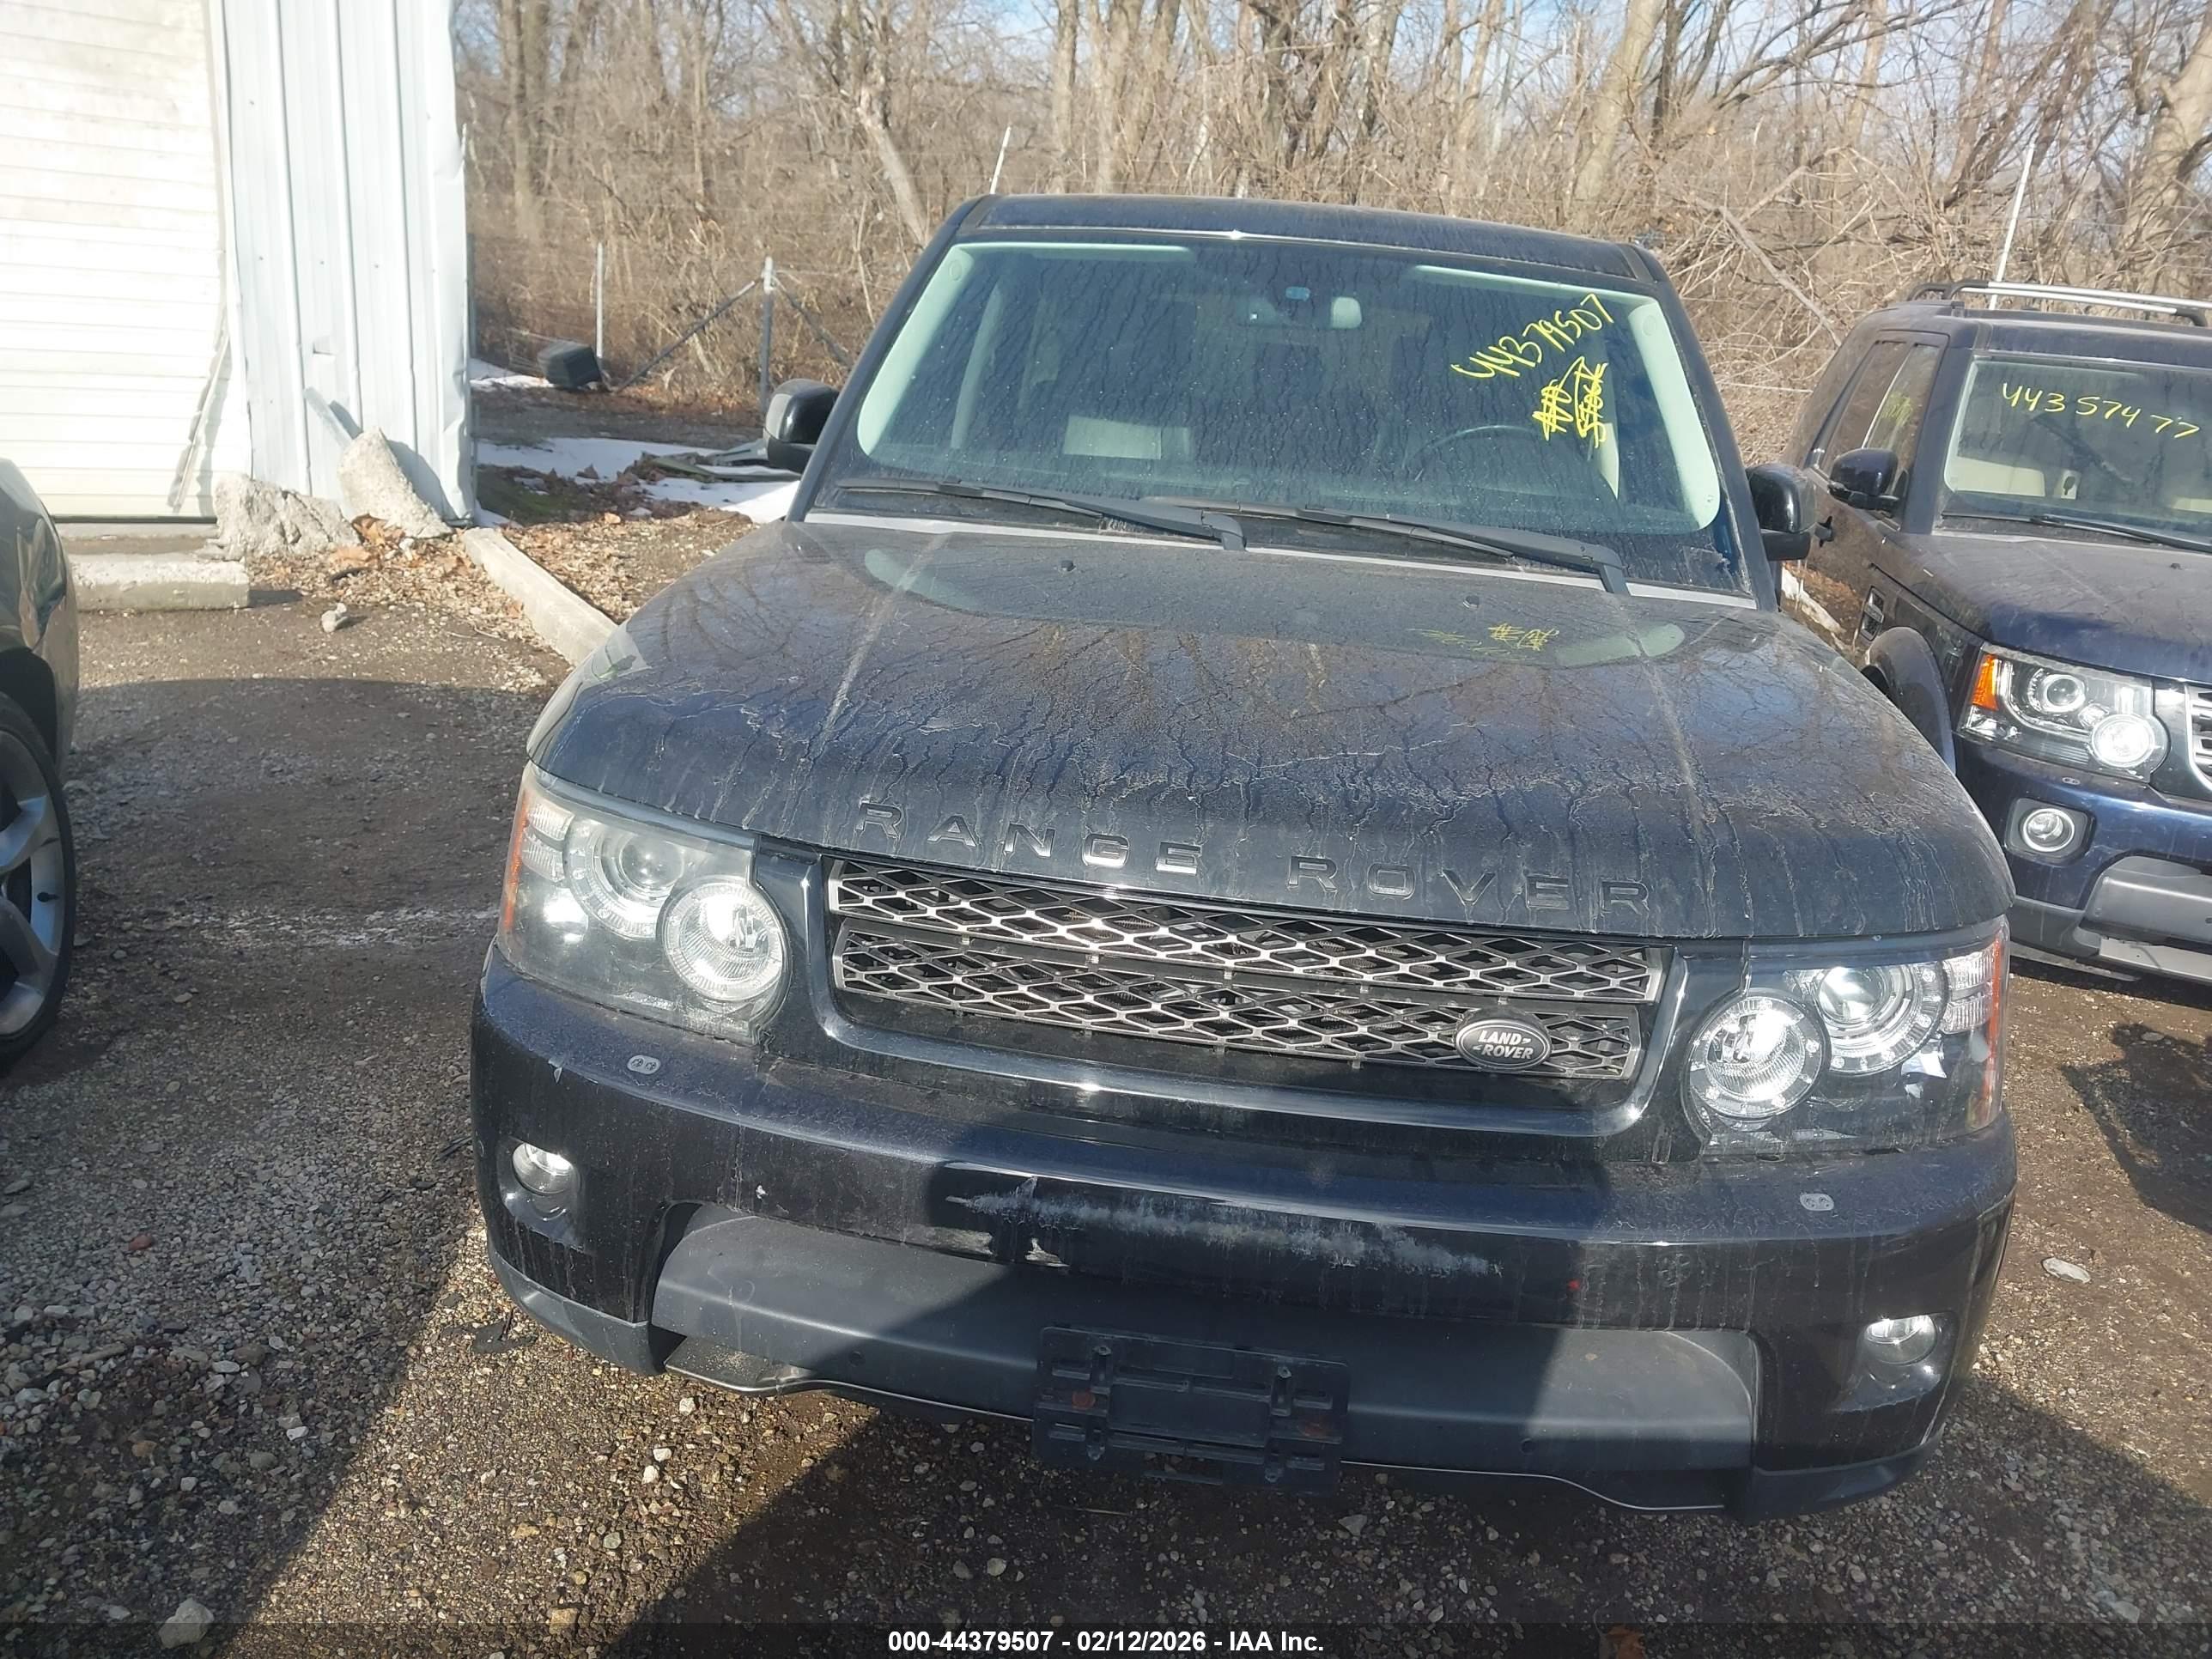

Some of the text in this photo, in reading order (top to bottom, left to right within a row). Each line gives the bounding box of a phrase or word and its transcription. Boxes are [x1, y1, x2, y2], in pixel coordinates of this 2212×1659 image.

[1451, 293, 1614, 378] 44379507
[855, 801, 1650, 914] RANGE ROVER
[1478, 1030, 1522, 1045] LAND
[1481, 1044, 1534, 1059] ROVER
